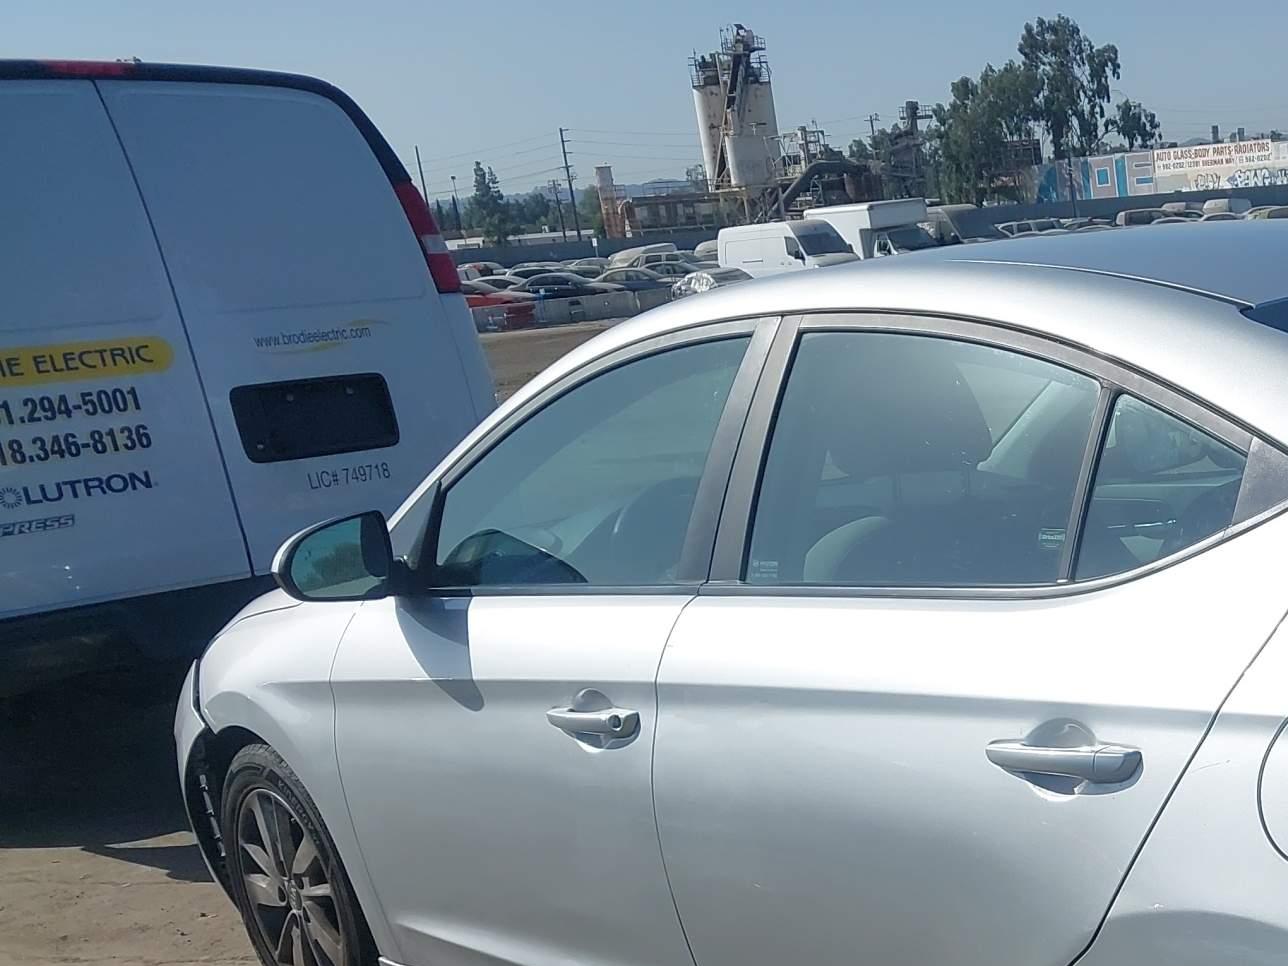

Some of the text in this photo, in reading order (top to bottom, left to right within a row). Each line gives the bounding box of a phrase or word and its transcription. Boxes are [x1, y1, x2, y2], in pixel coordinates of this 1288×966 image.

[1156, 151, 1171, 162] AUTO
[33, 345, 155, 375] ELECTRIC
[0, 386, 142, 425] 1.294-5001
[22, 470, 153, 506] LUTRON
[307, 462, 391, 490] LIC# 749718
